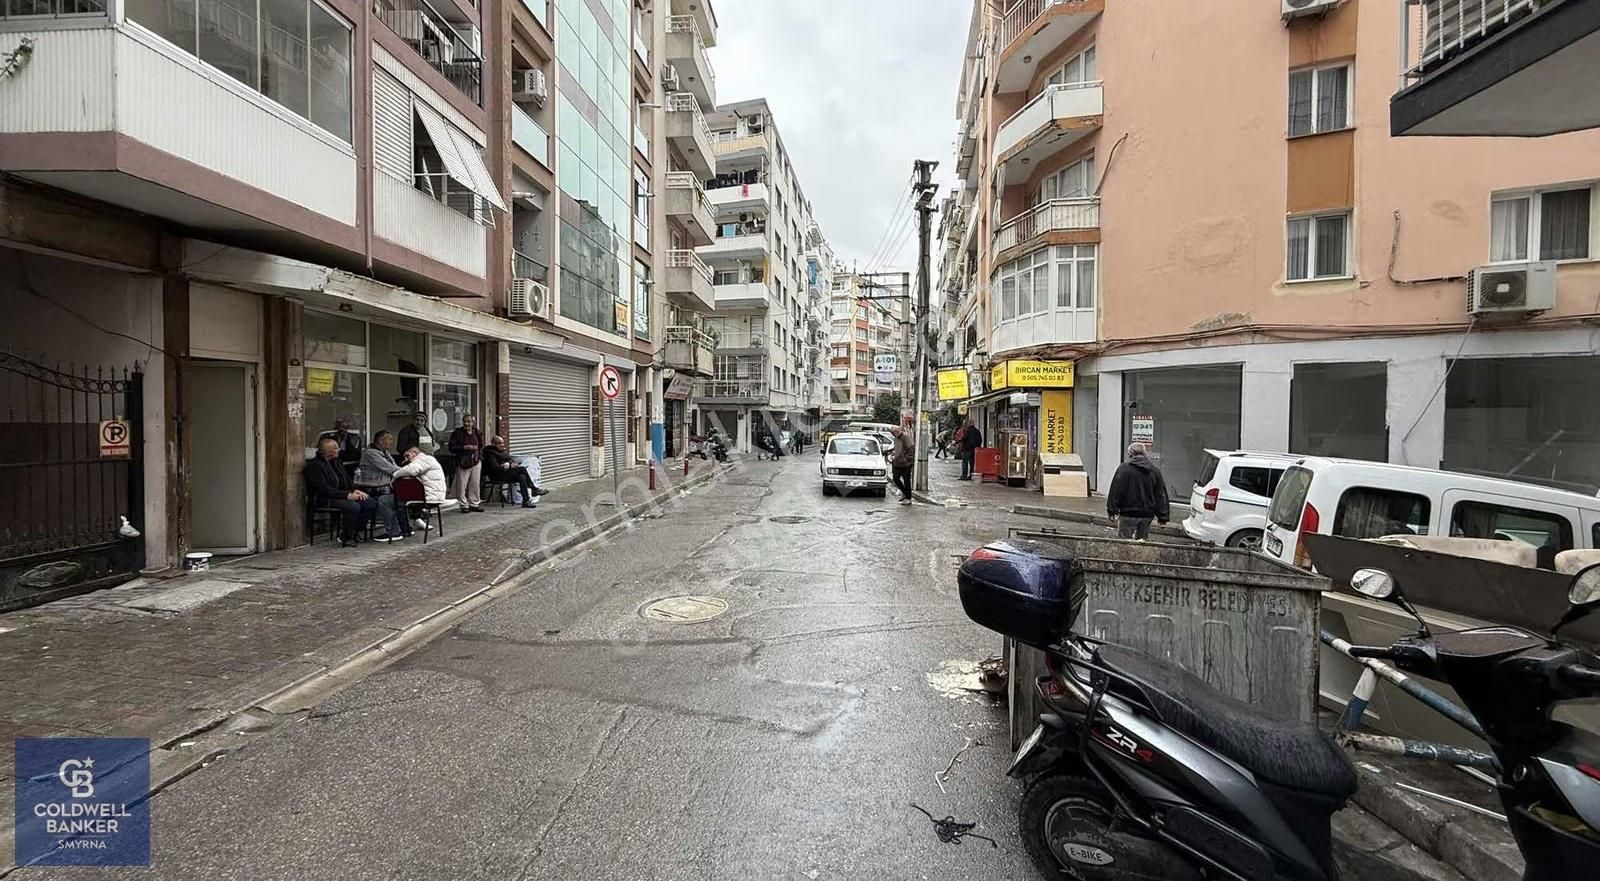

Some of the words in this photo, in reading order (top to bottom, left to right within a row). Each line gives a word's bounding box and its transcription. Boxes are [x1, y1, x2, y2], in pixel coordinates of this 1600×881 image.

[1042, 366, 1072, 374] MARKET
[1047, 408, 1056, 441] MARKET
[1070, 847, 1104, 862] E-BIKE
